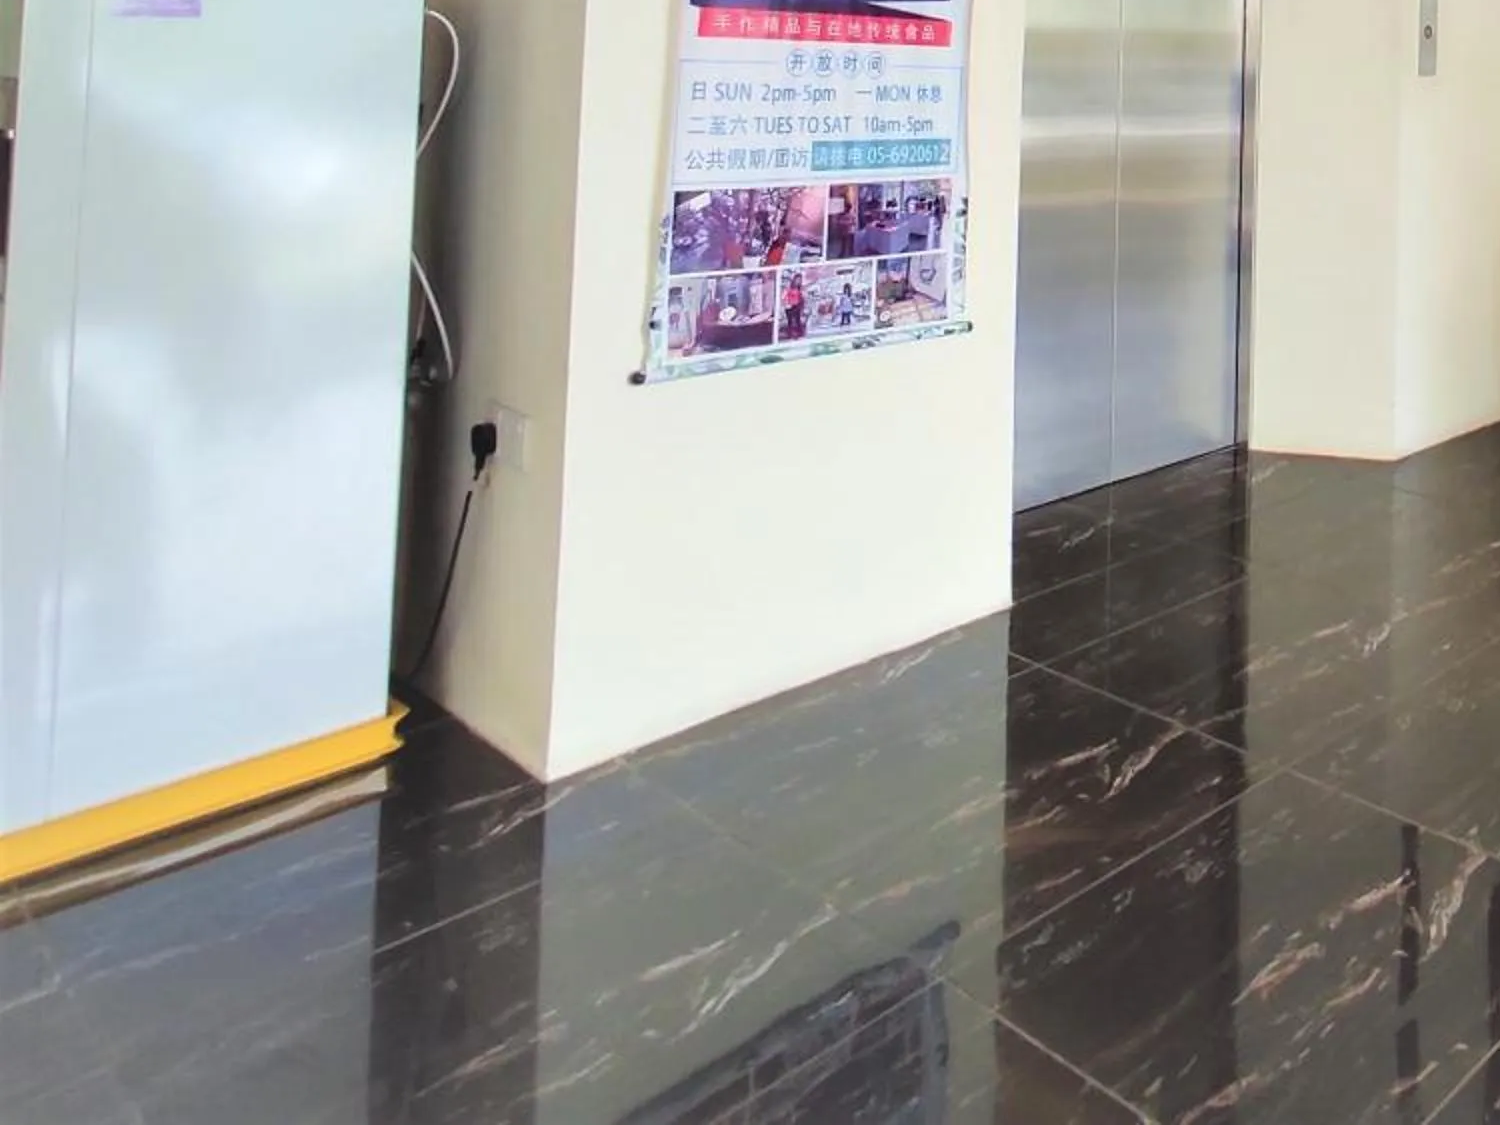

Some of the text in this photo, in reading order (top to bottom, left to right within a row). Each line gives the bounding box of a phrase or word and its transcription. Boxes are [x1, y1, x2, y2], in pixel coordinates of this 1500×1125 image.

[788, 53, 884, 74] 开放时间
[691, 81, 708, 101] 日
[714, 82, 752, 101] SUN
[761, 84, 836, 105] 2pm-5pm
[875, 85, 911, 102] MON
[687, 115, 933, 135] 二至六 TUES TO SAT 10am-5pm
